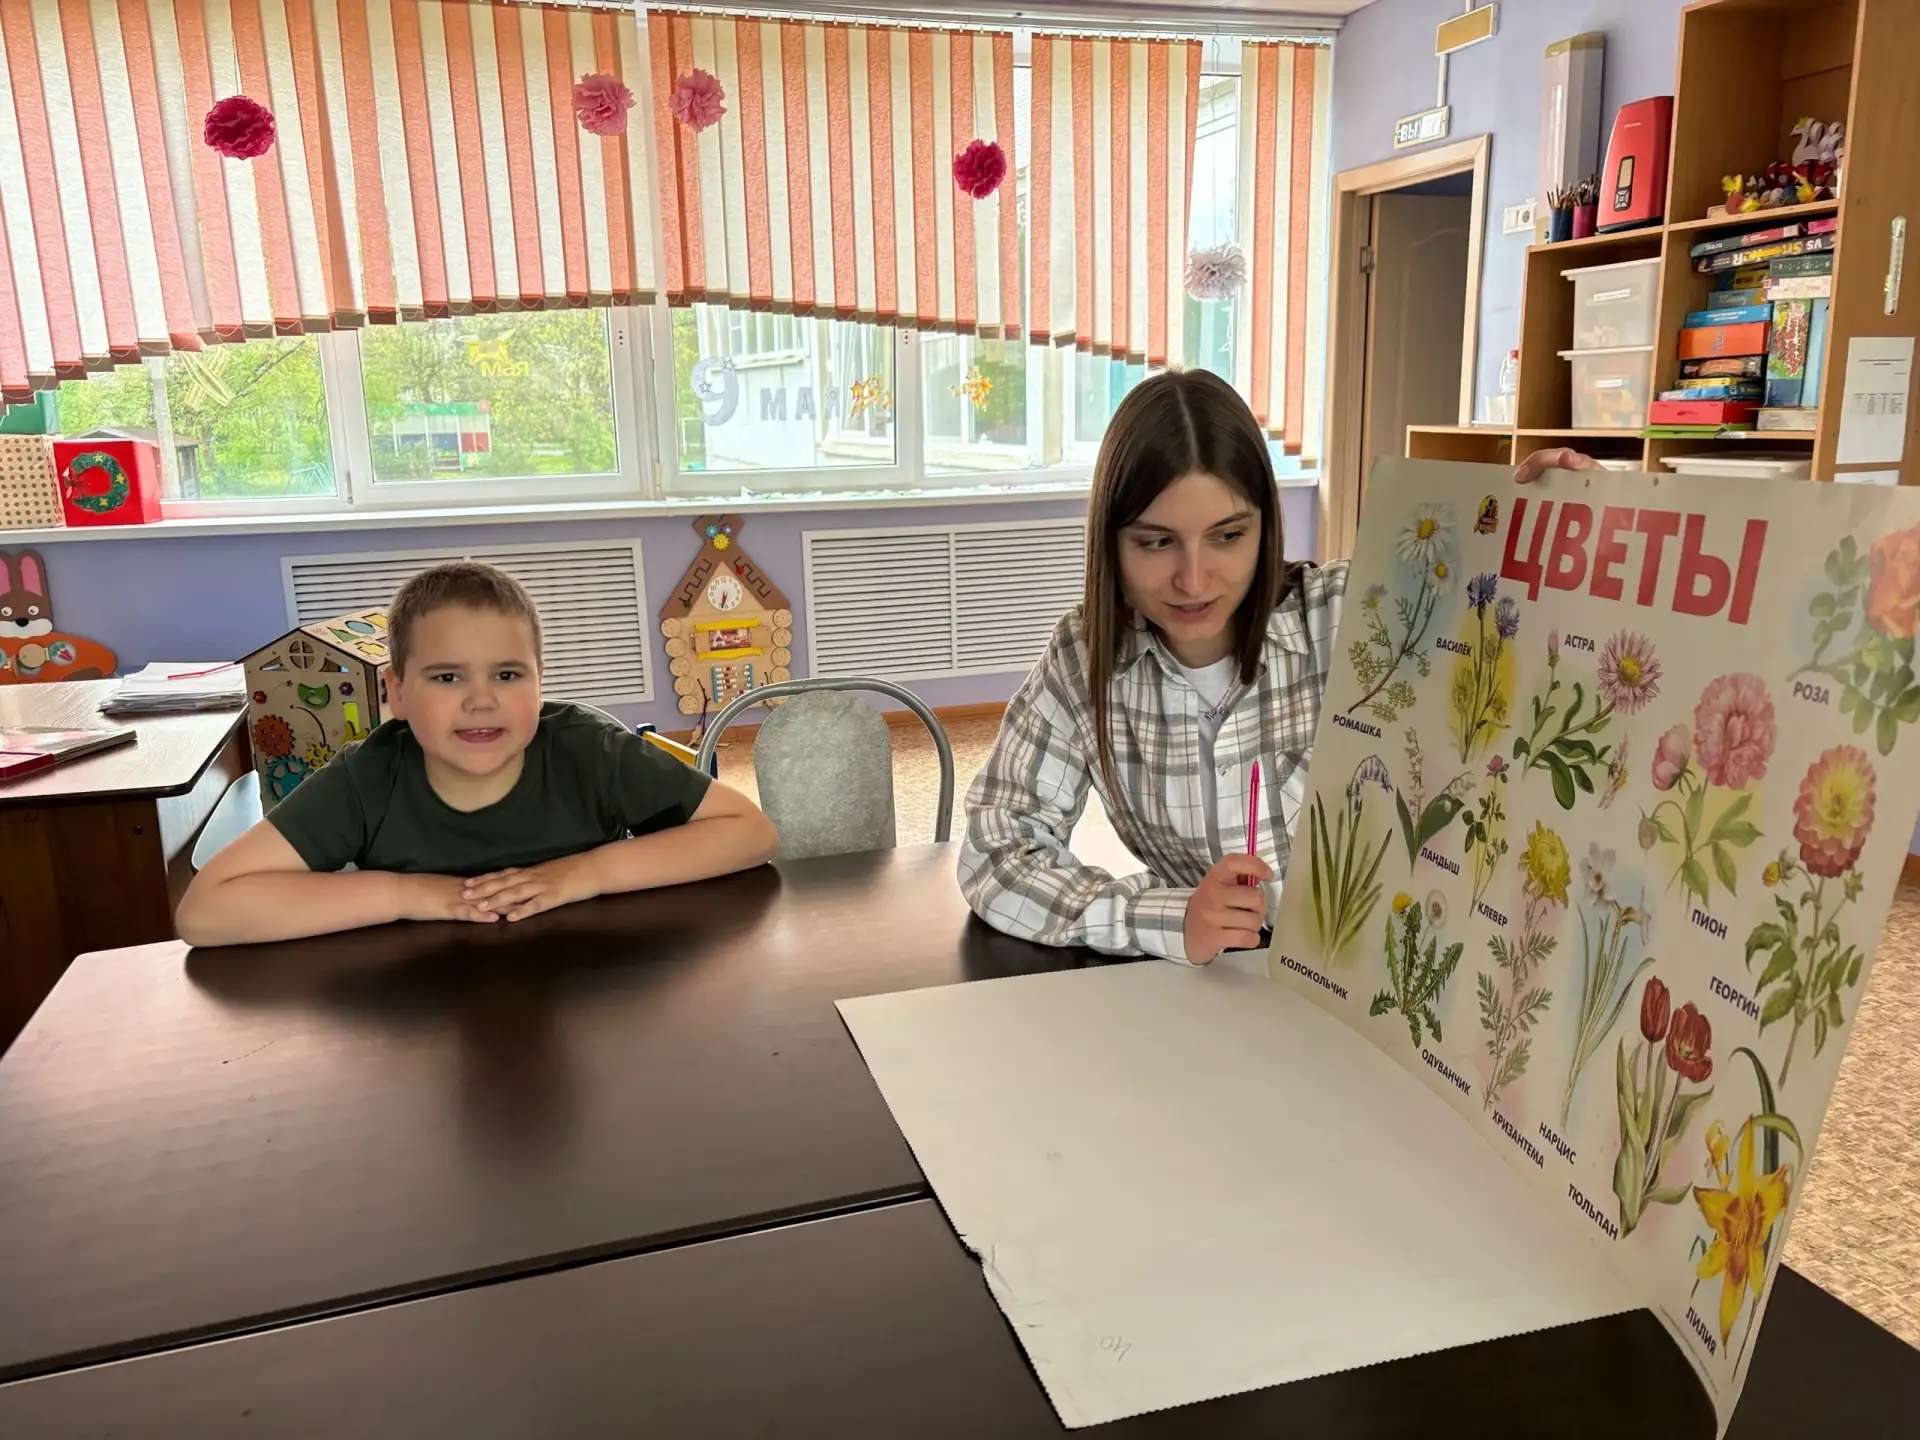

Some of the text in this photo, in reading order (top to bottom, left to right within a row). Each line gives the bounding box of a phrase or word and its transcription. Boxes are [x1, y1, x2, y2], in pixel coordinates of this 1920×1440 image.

[690, 356, 841, 426] 9 МАЯ
[1500, 497, 1769, 626] ЦВЕТЫ
[1436, 636, 1473, 657] ВАСИЛЁК
[1564, 633, 1596, 653] АСТРА
[1793, 681, 1830, 706] РОЗА
[1332, 713, 1382, 739] РОМАШКА
[1420, 846, 1460, 876] ЛАНДЫШ
[1477, 901, 1508, 928] КЛЕВЕР
[1691, 908, 1728, 940] ПИОН
[1280, 953, 1349, 1001] КОЛОКОЛЬЧИК
[1709, 974, 1760, 1021] ГЕОРГИН
[1421, 1048, 1471, 1096] ОДУВАНЧИК
[1491, 1109, 1545, 1169] ХРИЗАНТЕМА
[1539, 1121, 1577, 1166] НАРЦИС
[1568, 1183, 1619, 1240] ТЮЛЬПАН
[1685, 1305, 1718, 1357] ЛИЛИЯ
